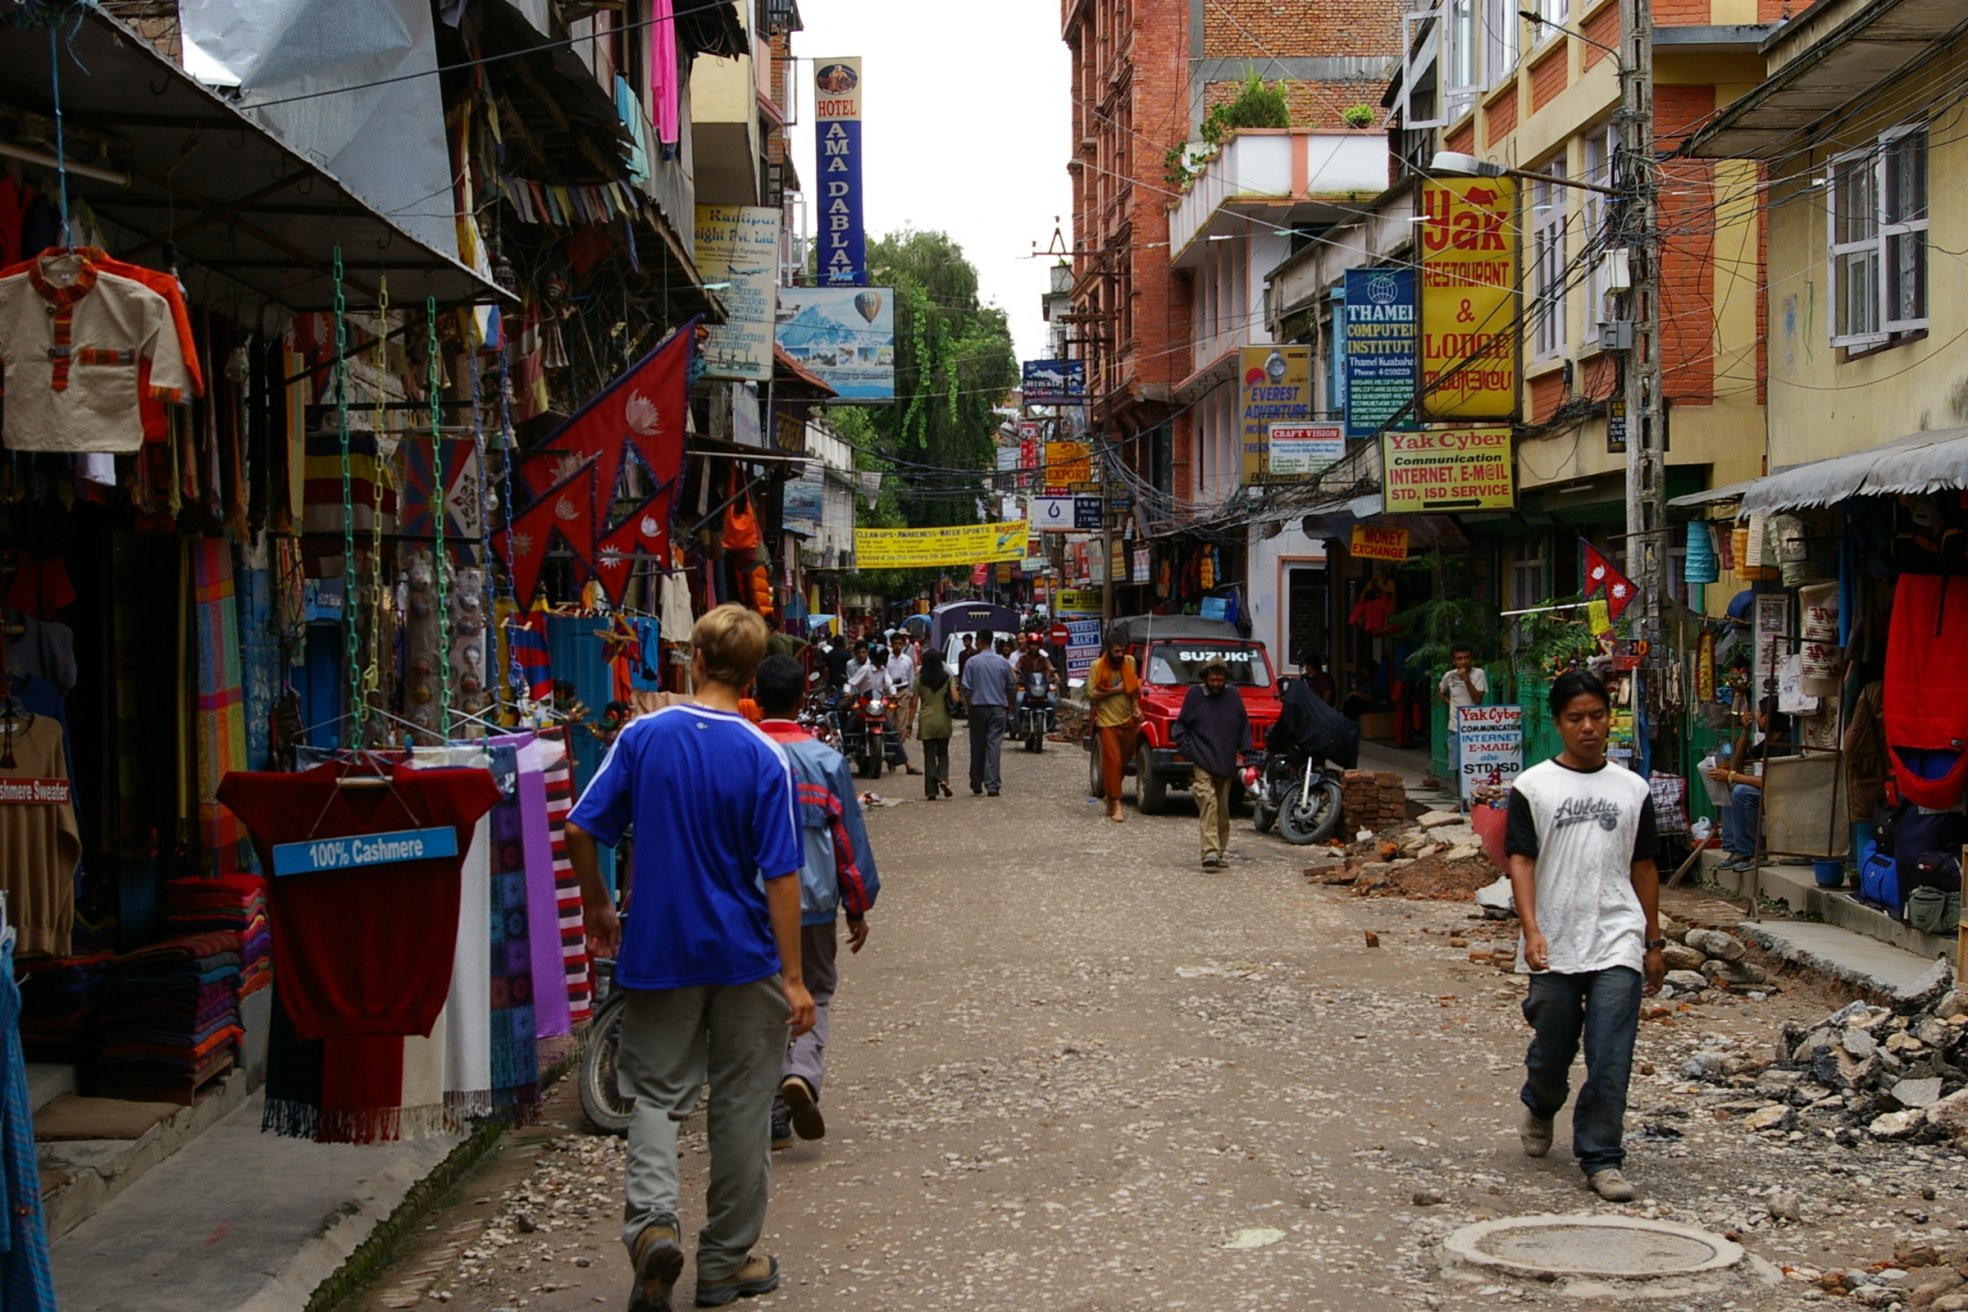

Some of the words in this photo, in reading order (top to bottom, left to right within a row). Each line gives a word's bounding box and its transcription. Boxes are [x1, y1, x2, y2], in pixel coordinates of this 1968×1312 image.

[818, 99, 856, 116] HOTEL
[825, 122, 850, 172] AMA
[828, 181, 853, 281] DABLAM
[1424, 261, 1509, 287] RESTAURANT
[1456, 298, 1475, 323] &
[1425, 333, 1510, 359] LODGE
[1251, 387, 1299, 401] EVEREST
[1274, 430, 1303, 439] CRAFT
[1306, 429, 1338, 438] VISION
[1390, 434, 1435, 450] Yak
[1438, 431, 1506, 451] Cyber
[1394, 453, 1502, 466] Communication
[1047, 469, 1088, 480] EXPORT
[1390, 466, 1457, 485] INTERNET,
[1461, 464, 1508, 482] E-M@IL
[1391, 488, 1420, 500] STD,
[1425, 487, 1447, 498] ISD
[1451, 484, 1509, 497] SERVICE
[1364, 527, 1404, 546] MONEY
[1353, 543, 1405, 558] EXCHANGE
[1179, 651, 1248, 662] SUZUKI
[1461, 709, 1488, 721] Yak
[1489, 707, 1522, 723] Cyber
[1461, 723, 1521, 733] COMMUNICATION
[1462, 734, 1519, 742] INTERNET
[1468, 743, 1513, 752] E-MAIL
[34, 780, 69, 801] Sweater
[1554, 796, 1619, 819] Athletics
[309, 842, 350, 867] 100%
[352, 838, 424, 863] Cashmere
